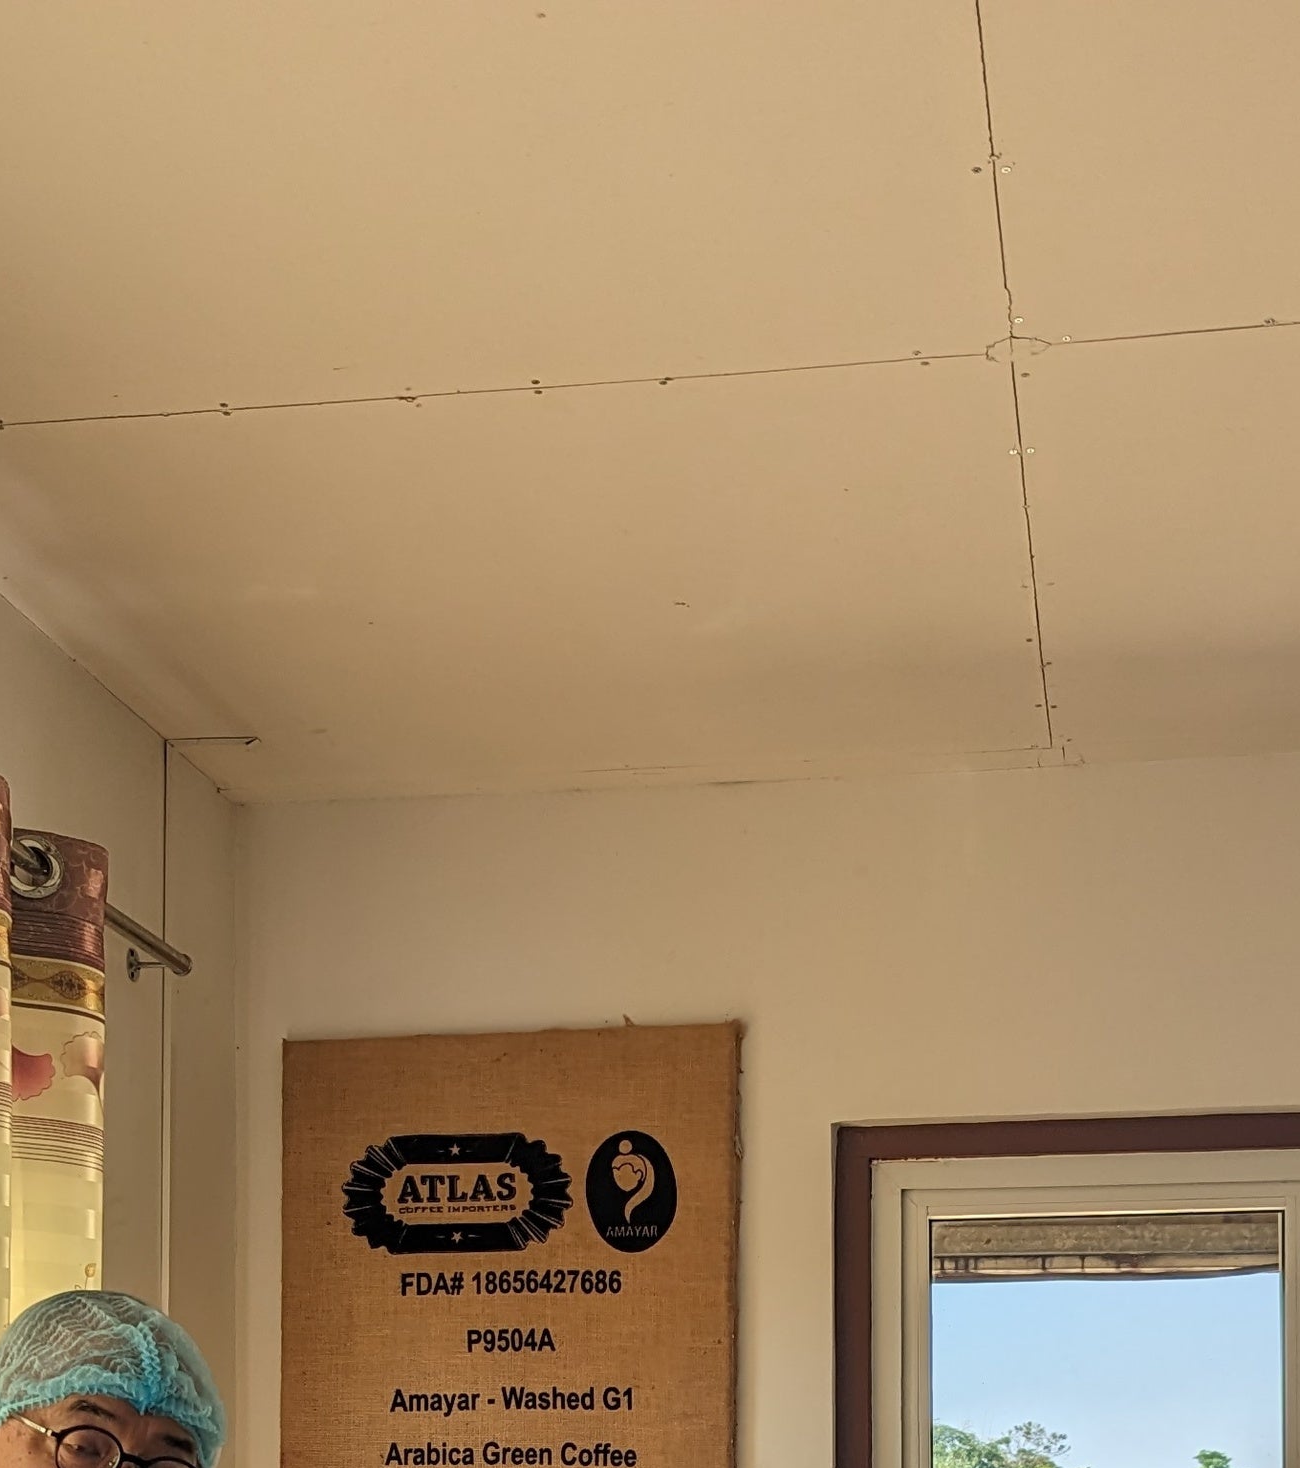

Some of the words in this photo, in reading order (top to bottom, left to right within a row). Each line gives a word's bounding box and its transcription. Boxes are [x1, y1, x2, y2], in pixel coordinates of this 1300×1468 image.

[397, 1173, 517, 1204] ATLAS
[448, 1204, 516, 1213] IMPORTERS
[606, 1225, 657, 1238] AMAYAR
[400, 1272, 464, 1296] FDA#
[472, 1269, 621, 1294] 18656427686
[467, 1328, 556, 1352] P9504A
[390, 1389, 480, 1417] Amayar
[502, 1387, 594, 1410] Washed
[603, 1387, 633, 1410] G1
[385, 1442, 474, 1466] Arabica
[483, 1442, 552, 1466] Green
[561, 1443, 637, 1467] Coffee
